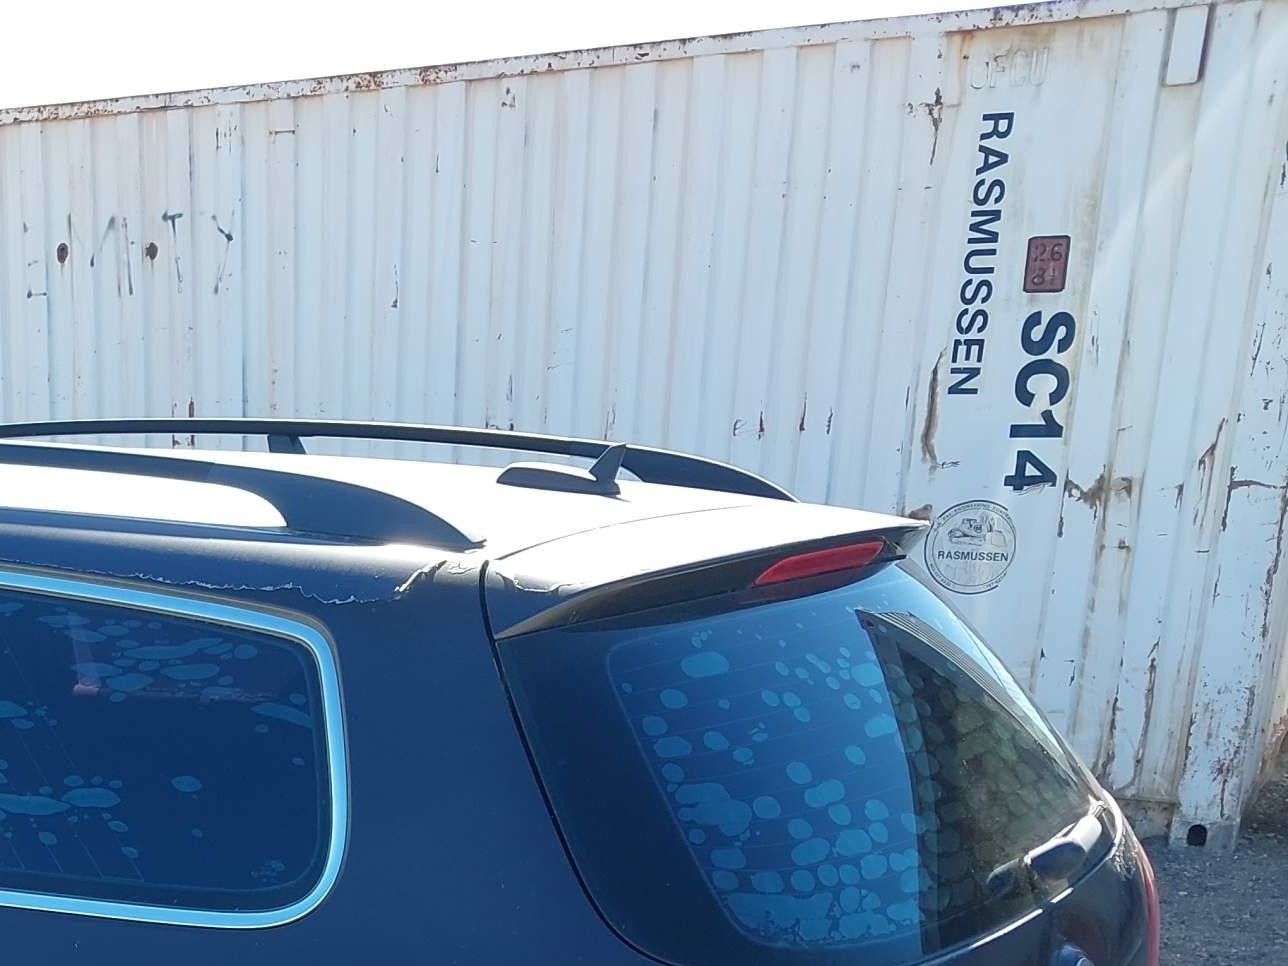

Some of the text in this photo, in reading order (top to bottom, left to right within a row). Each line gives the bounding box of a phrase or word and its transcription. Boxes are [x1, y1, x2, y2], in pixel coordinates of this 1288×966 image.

[947, 111, 1015, 395] RASMUSSEN
[1003, 310, 1076, 492] SC14
[937, 550, 1009, 562] RASMUSSEN
